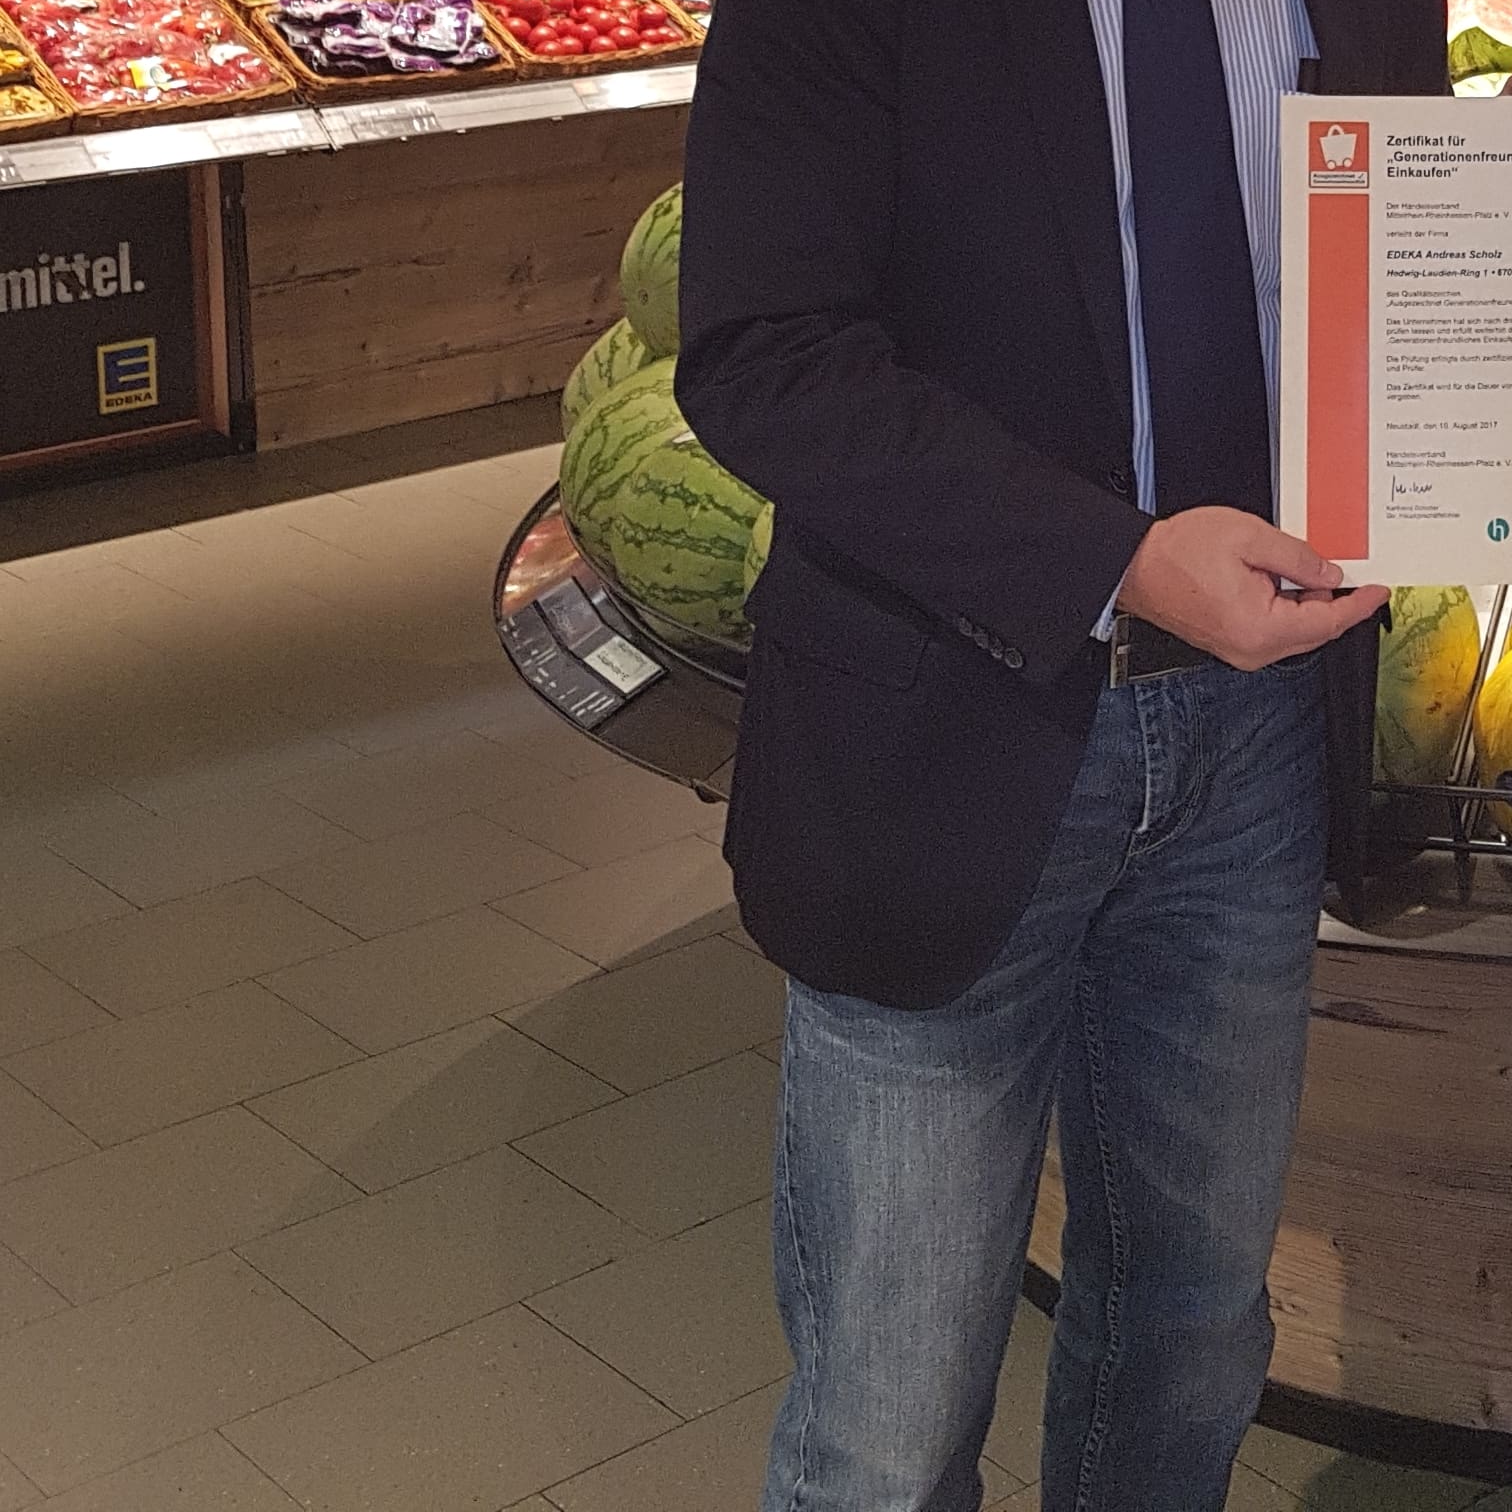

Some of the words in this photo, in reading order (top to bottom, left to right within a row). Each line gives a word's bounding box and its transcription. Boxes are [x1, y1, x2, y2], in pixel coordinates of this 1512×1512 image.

[1387, 135, 1444, 147] Zertifikat
[1448, 135, 1466, 147] für
[1386, 250, 1422, 259] EDEKA
[1425, 250, 1466, 259] Andreas
[1469, 249, 1503, 259] Scholz
[105, 392, 153, 408] EDEKA
